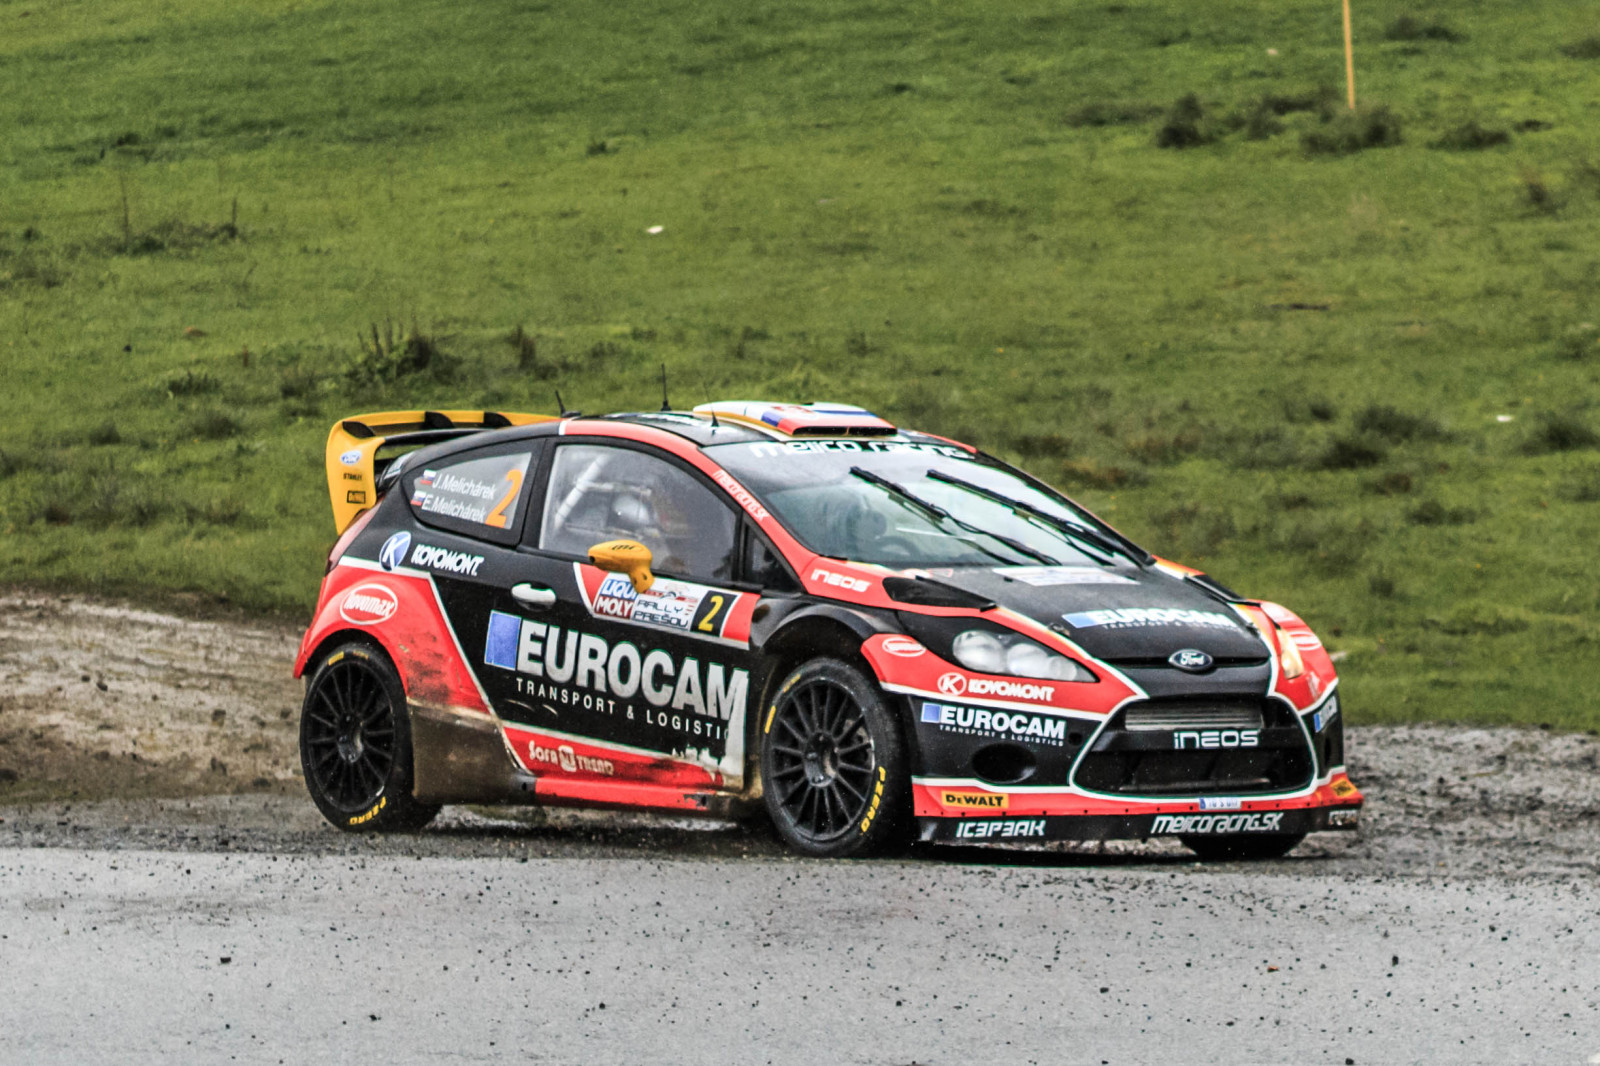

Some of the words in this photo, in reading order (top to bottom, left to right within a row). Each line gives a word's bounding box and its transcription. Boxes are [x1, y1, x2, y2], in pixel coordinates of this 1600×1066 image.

[486, 470, 522, 528] 2
[597, 596, 634, 617] MOLY
[637, 599, 683, 614] RALLY
[698, 595, 724, 632] 2
[517, 618, 749, 721] EUROCAM
[516, 677, 615, 715] TRANSPORT
[626, 706, 635, 721] &
[939, 706, 1066, 740] EUROCAM
[940, 725, 996, 738] TRANSPORT
